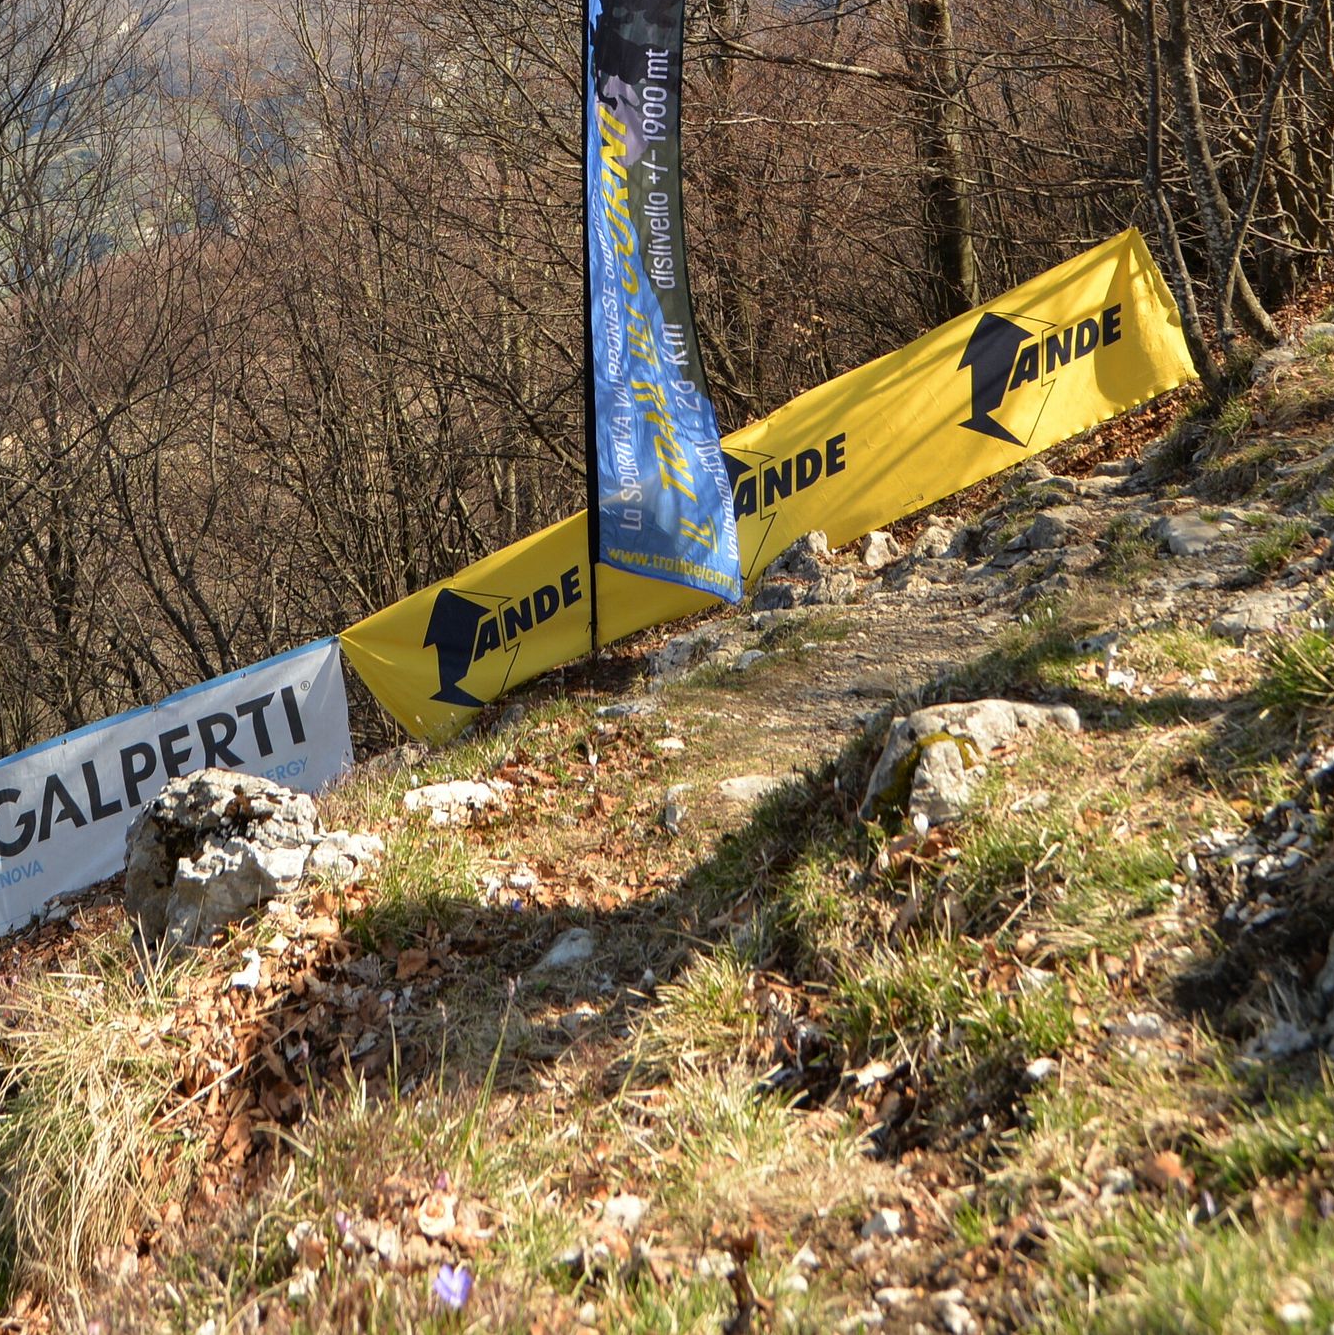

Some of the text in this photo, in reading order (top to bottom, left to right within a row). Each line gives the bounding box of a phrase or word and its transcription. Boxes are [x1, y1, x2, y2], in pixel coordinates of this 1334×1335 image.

[646, 48, 669, 80] mt
[643, 86, 667, 142] 1900
[644, 192, 676, 289] dislivello
[661, 323, 690, 366] Km
[1008, 303, 1122, 392] ANDE
[671, 380, 702, 413] 26
[612, 416, 643, 502] SPORTIVA
[733, 432, 846, 523] ANDE
[620, 510, 642, 531] La
[471, 565, 582, 663] ANDE
